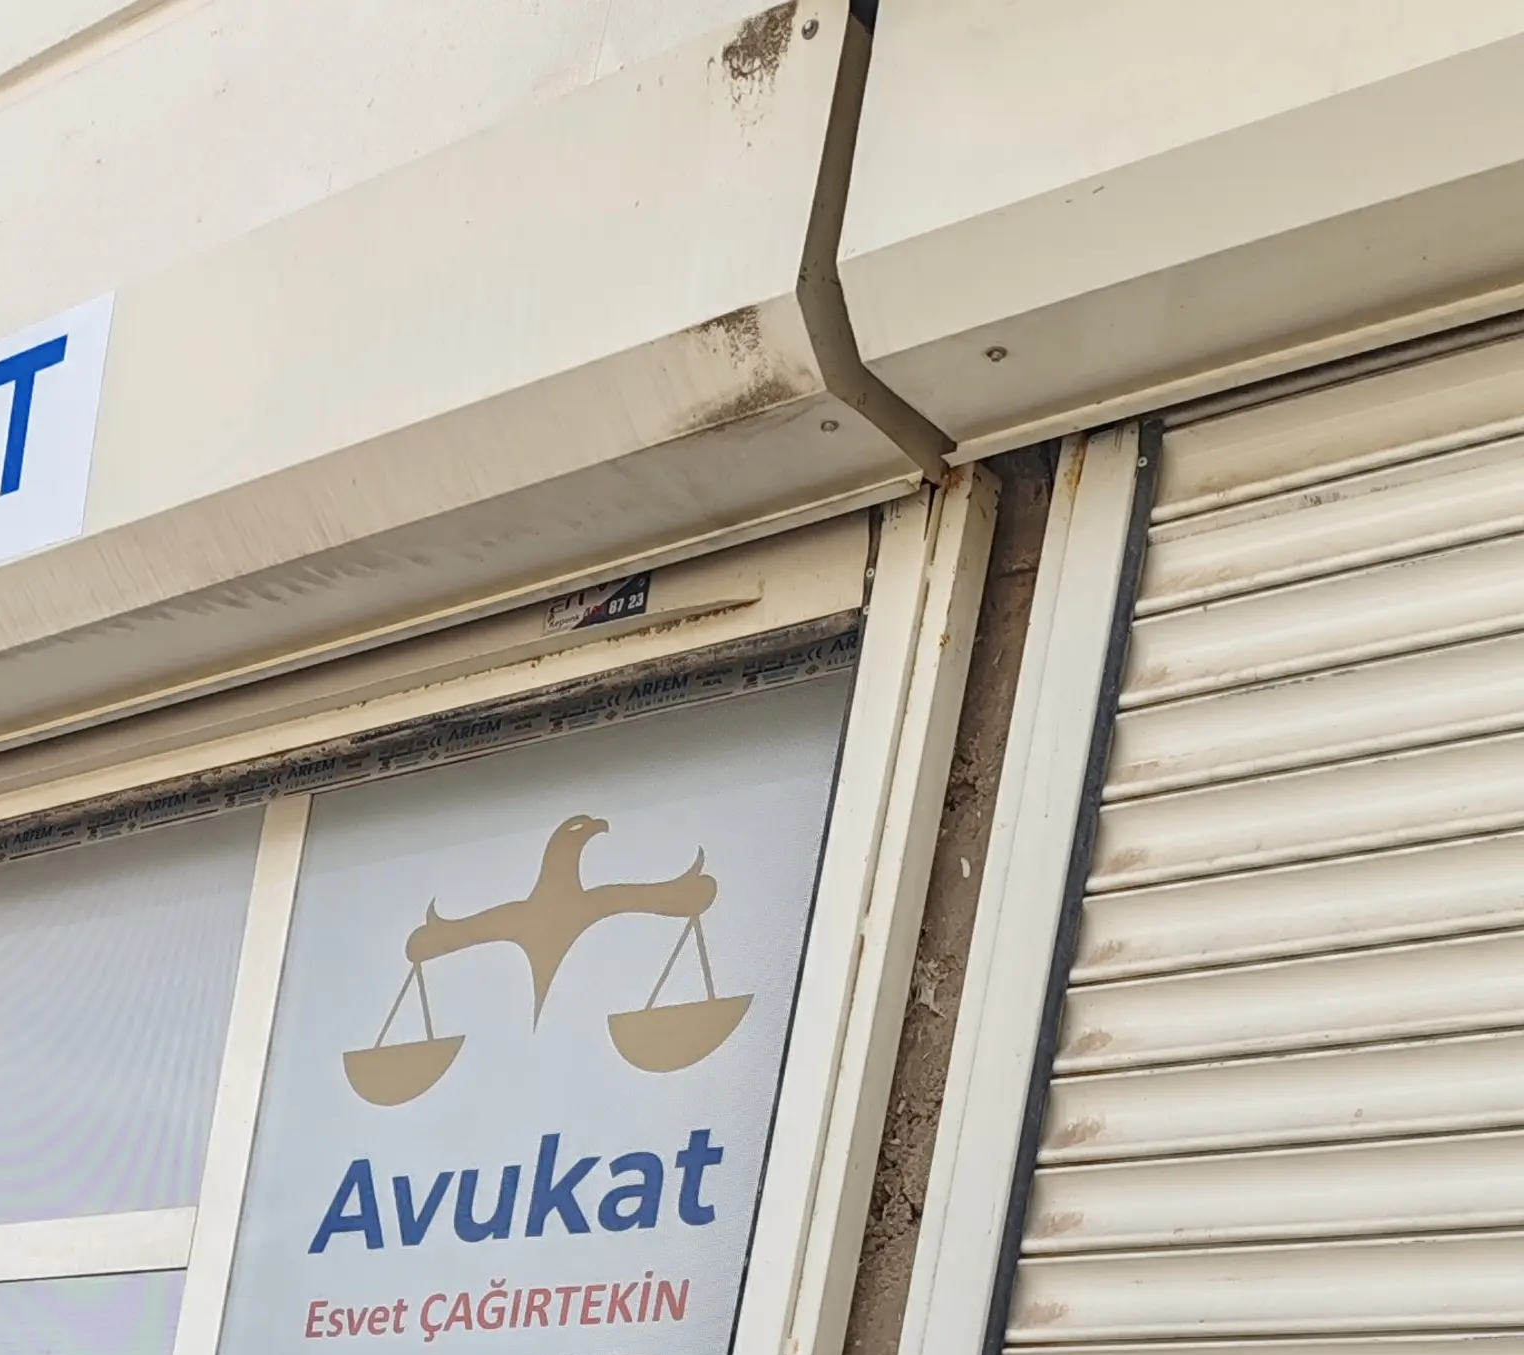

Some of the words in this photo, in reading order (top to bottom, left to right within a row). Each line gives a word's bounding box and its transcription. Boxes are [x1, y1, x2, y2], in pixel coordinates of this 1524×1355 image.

[608, 598, 625, 614] 87
[627, 591, 644, 609] 23
[628, 675, 688, 701] ARFEM
[308, 1128, 724, 1254] Avukat
[305, 1298, 407, 1338] Esvet
[420, 1270, 690, 1343] ÇAĞIRTEKİN
